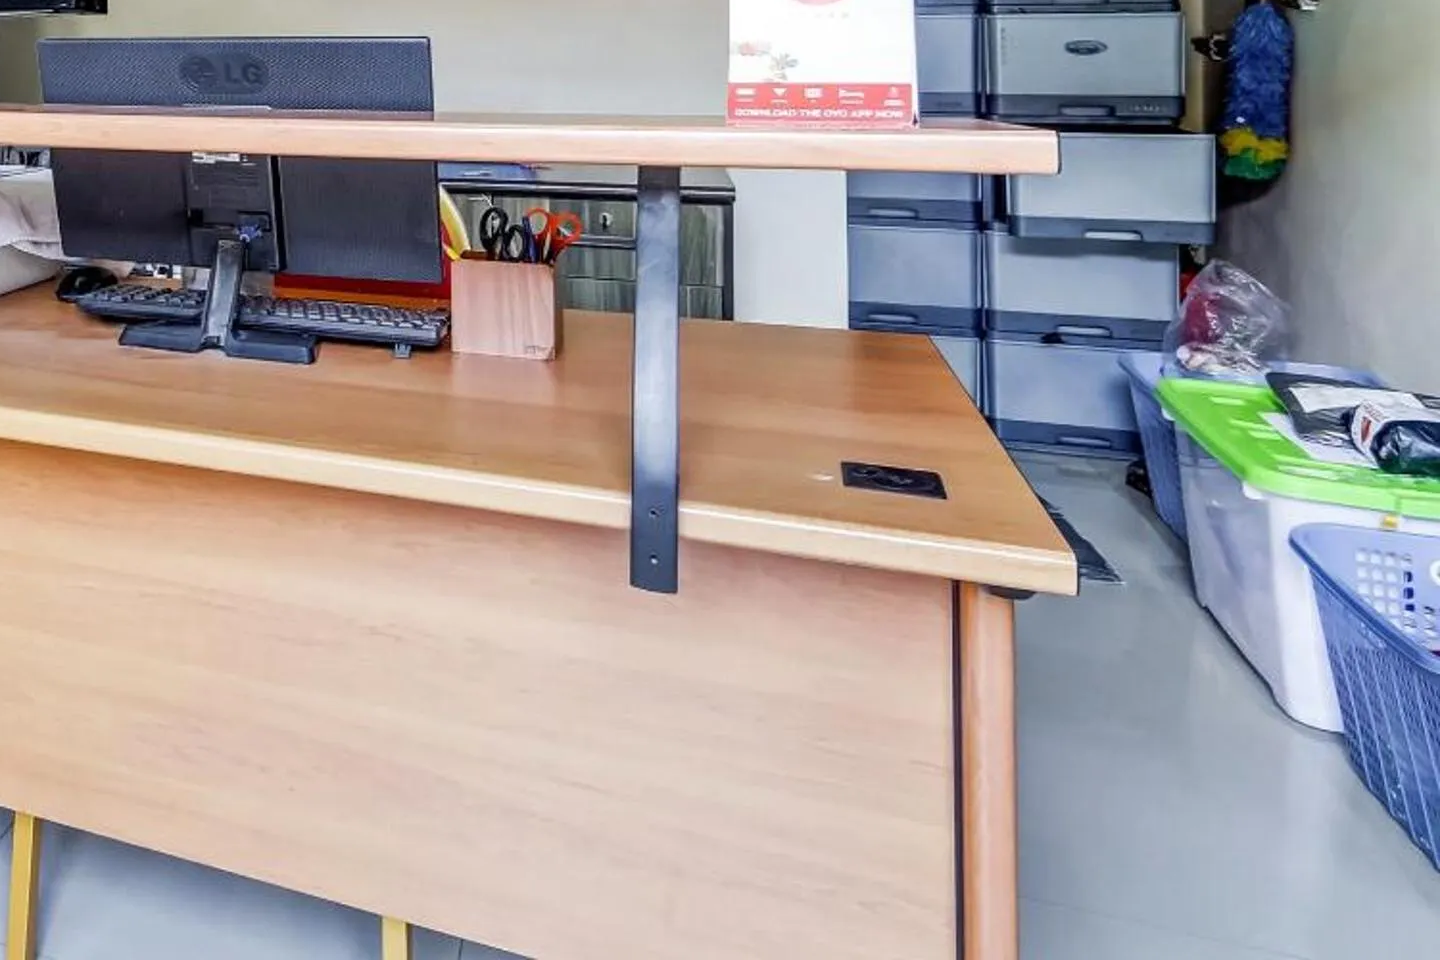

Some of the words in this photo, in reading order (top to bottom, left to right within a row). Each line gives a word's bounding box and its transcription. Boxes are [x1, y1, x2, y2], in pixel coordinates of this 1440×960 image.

[224, 62, 262, 84] LG
[735, 108, 797, 117] DOWNLOAD
[799, 108, 821, 117] THE
[851, 109, 876, 118] APP
